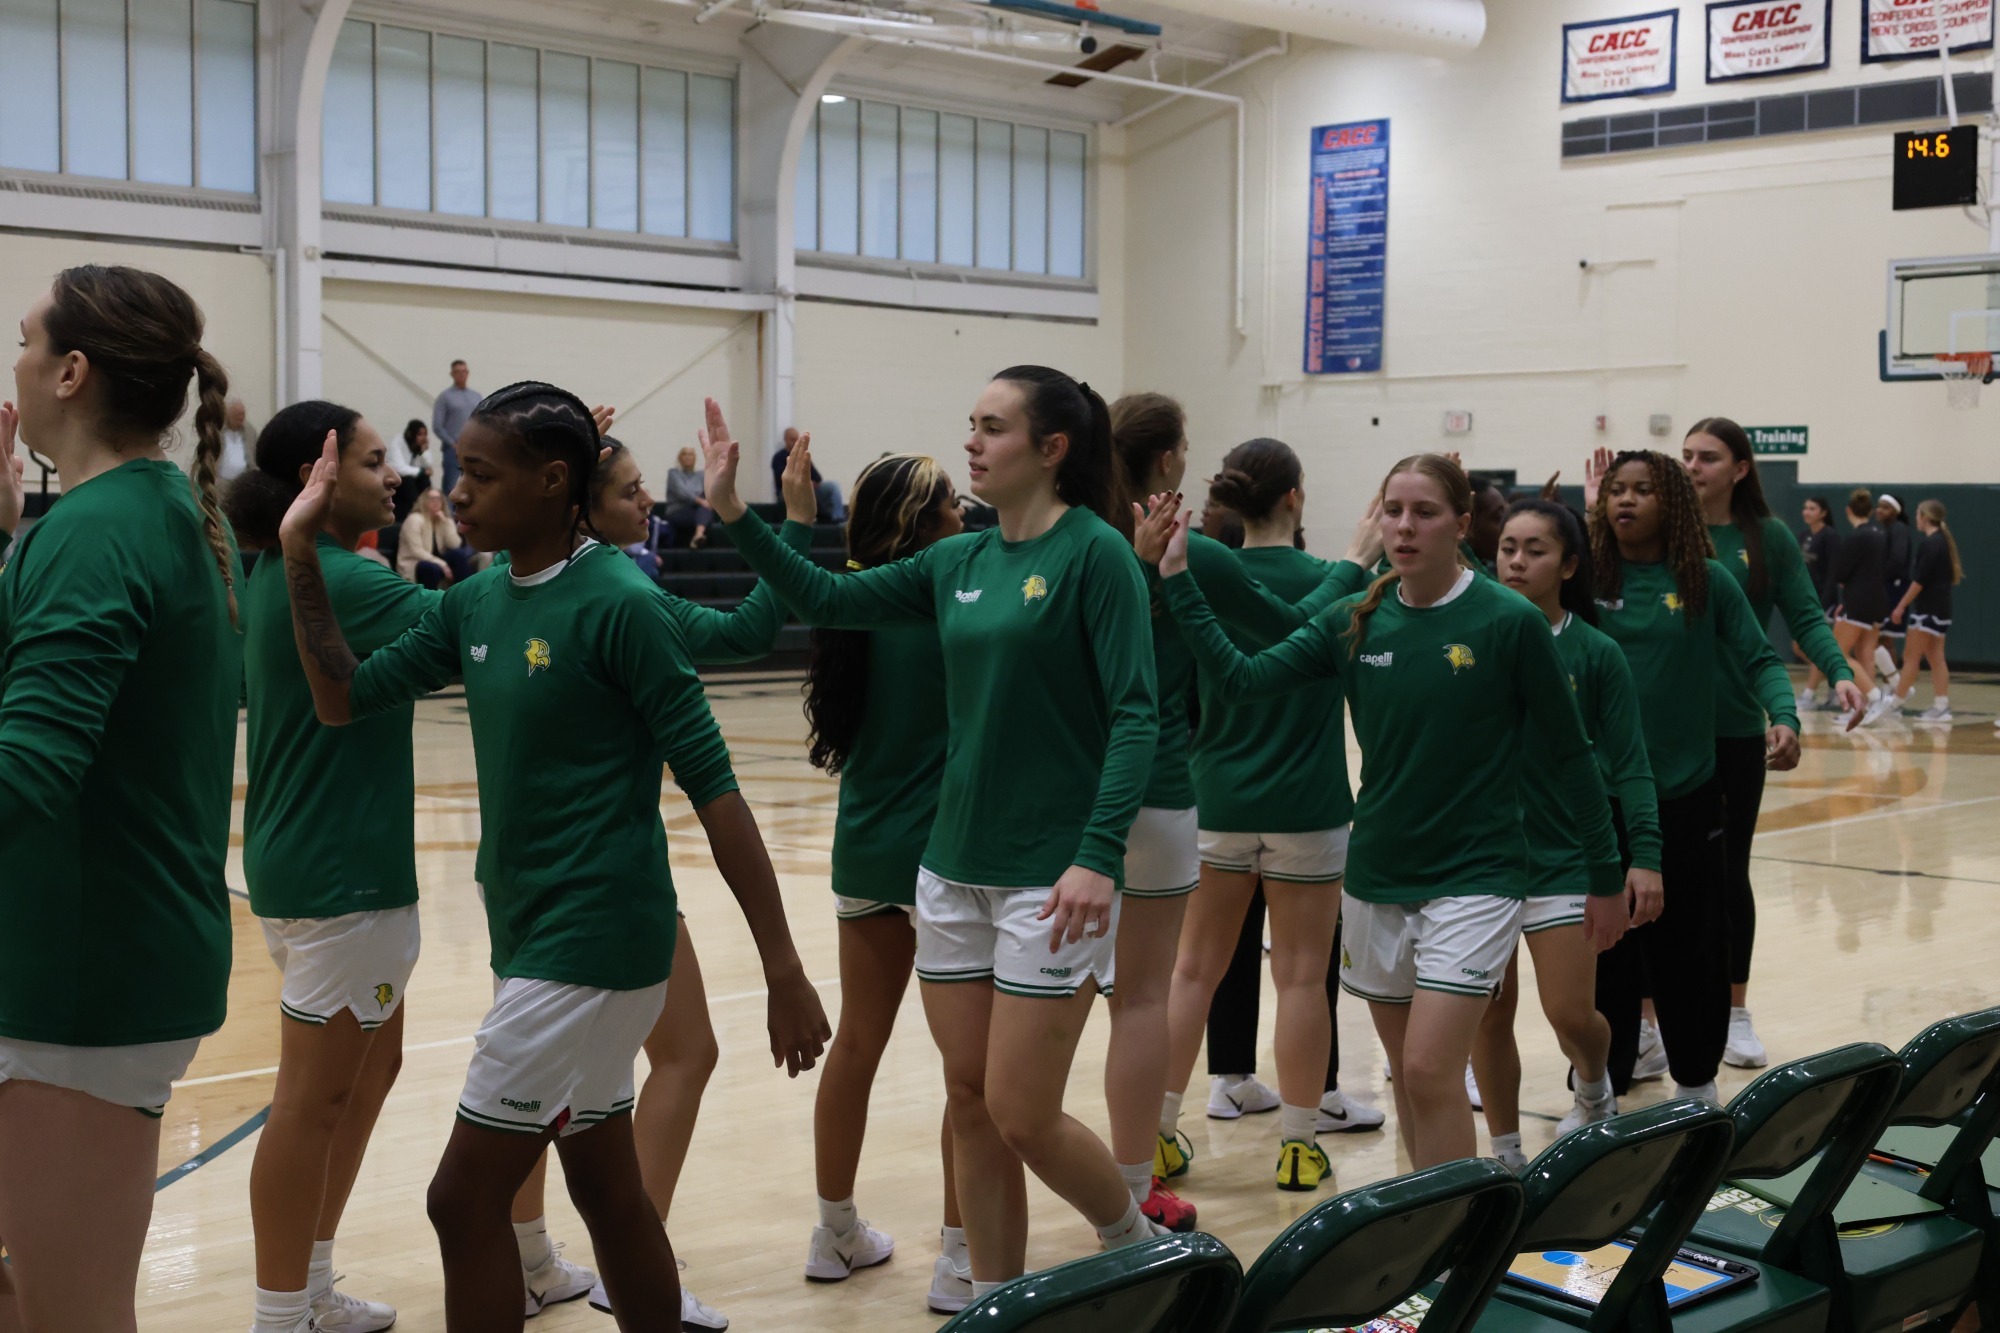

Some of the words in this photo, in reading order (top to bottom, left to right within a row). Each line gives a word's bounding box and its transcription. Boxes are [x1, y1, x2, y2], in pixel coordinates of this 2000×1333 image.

[1732, 4, 1802, 32] CACC
[1870, 6, 1935, 22] CONFERENCE
[1903, 21, 1937, 34] CROSS
[1588, 28, 1651, 53] CACC
[1909, 33, 1950, 47] 200
[1323, 125, 1378, 150] CACC
[1907, 133, 1950, 159] 14.6
[1755, 429, 1806, 446] Training
[1360, 652, 1393, 665] capelli
[1040, 967, 1072, 977] capelli
[500, 1097, 541, 1111] capelli
